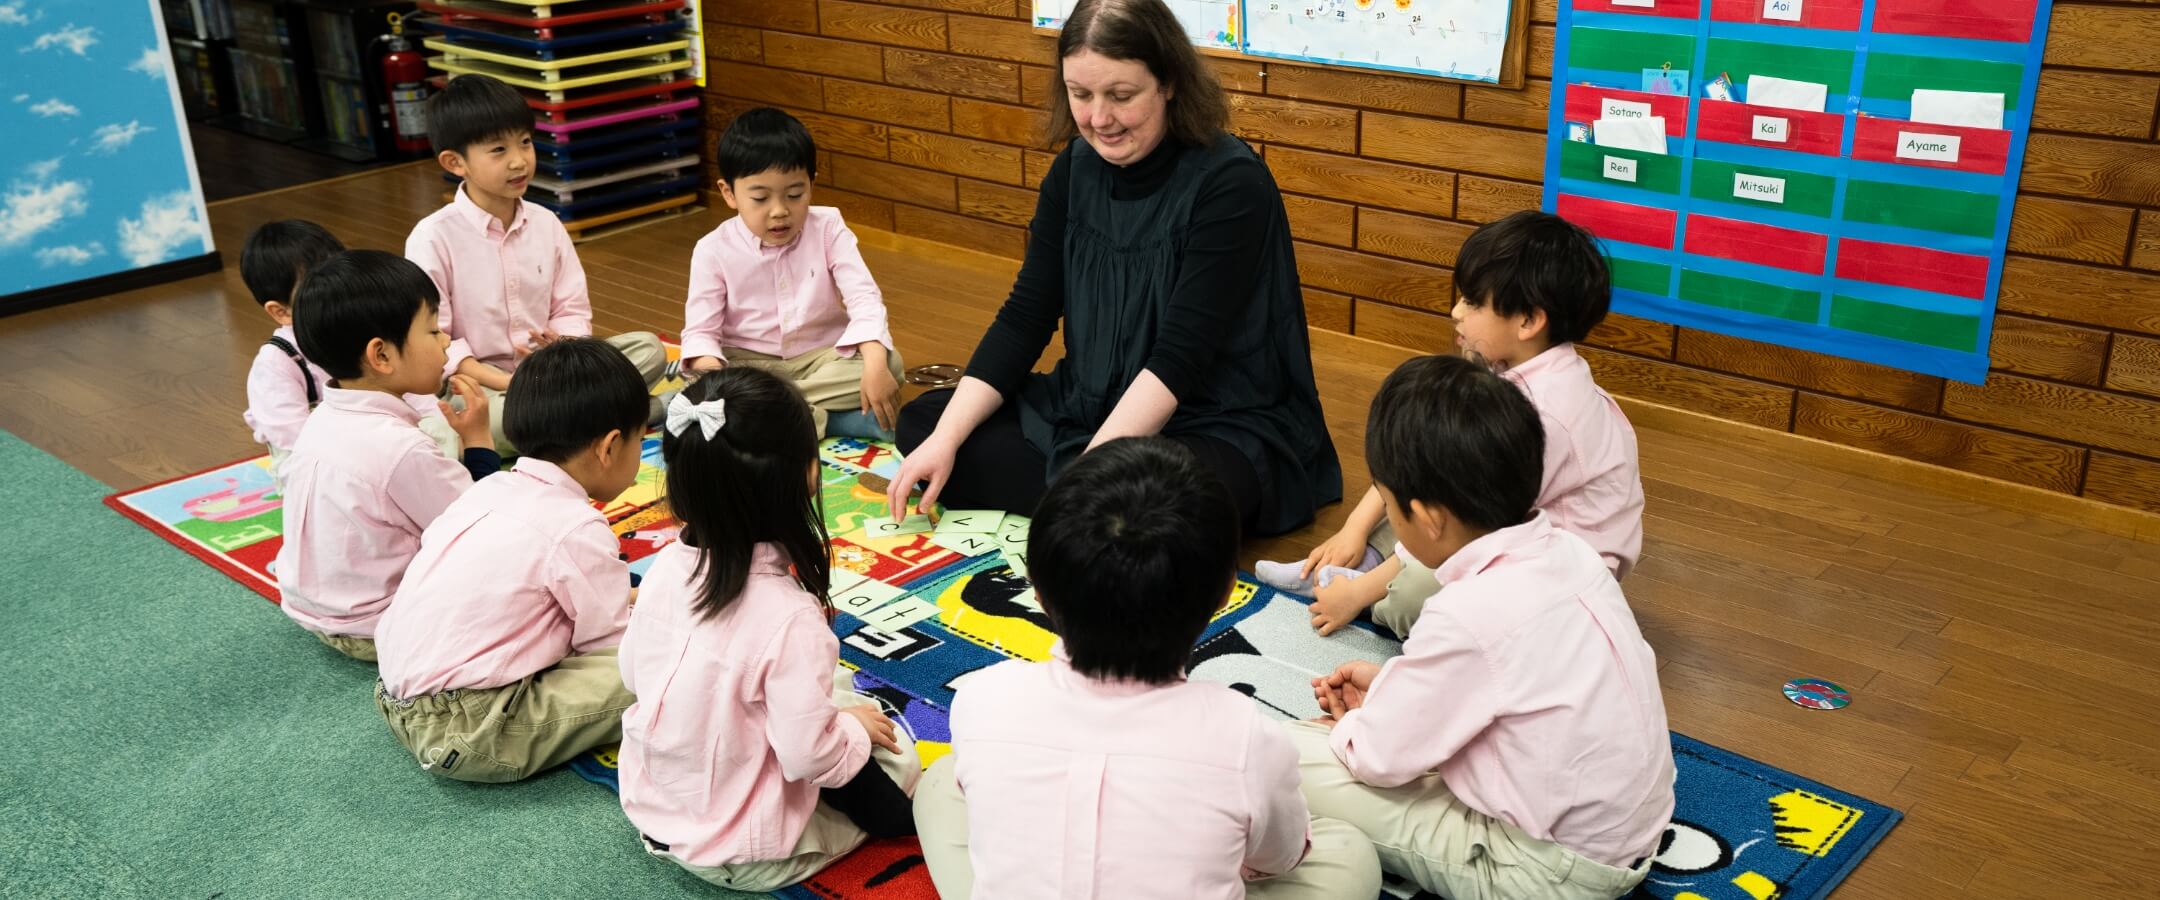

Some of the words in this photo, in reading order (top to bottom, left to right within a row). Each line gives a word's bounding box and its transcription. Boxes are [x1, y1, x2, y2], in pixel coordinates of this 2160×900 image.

[1772, 1, 1790, 11] Aoi
[1609, 106, 1642, 118] Sotaro
[1761, 123, 1777, 134] Kai
[1906, 139, 1947, 153] Ayame
[1610, 162, 1628, 174] Ren
[1739, 180, 1779, 194] Mitsuki
